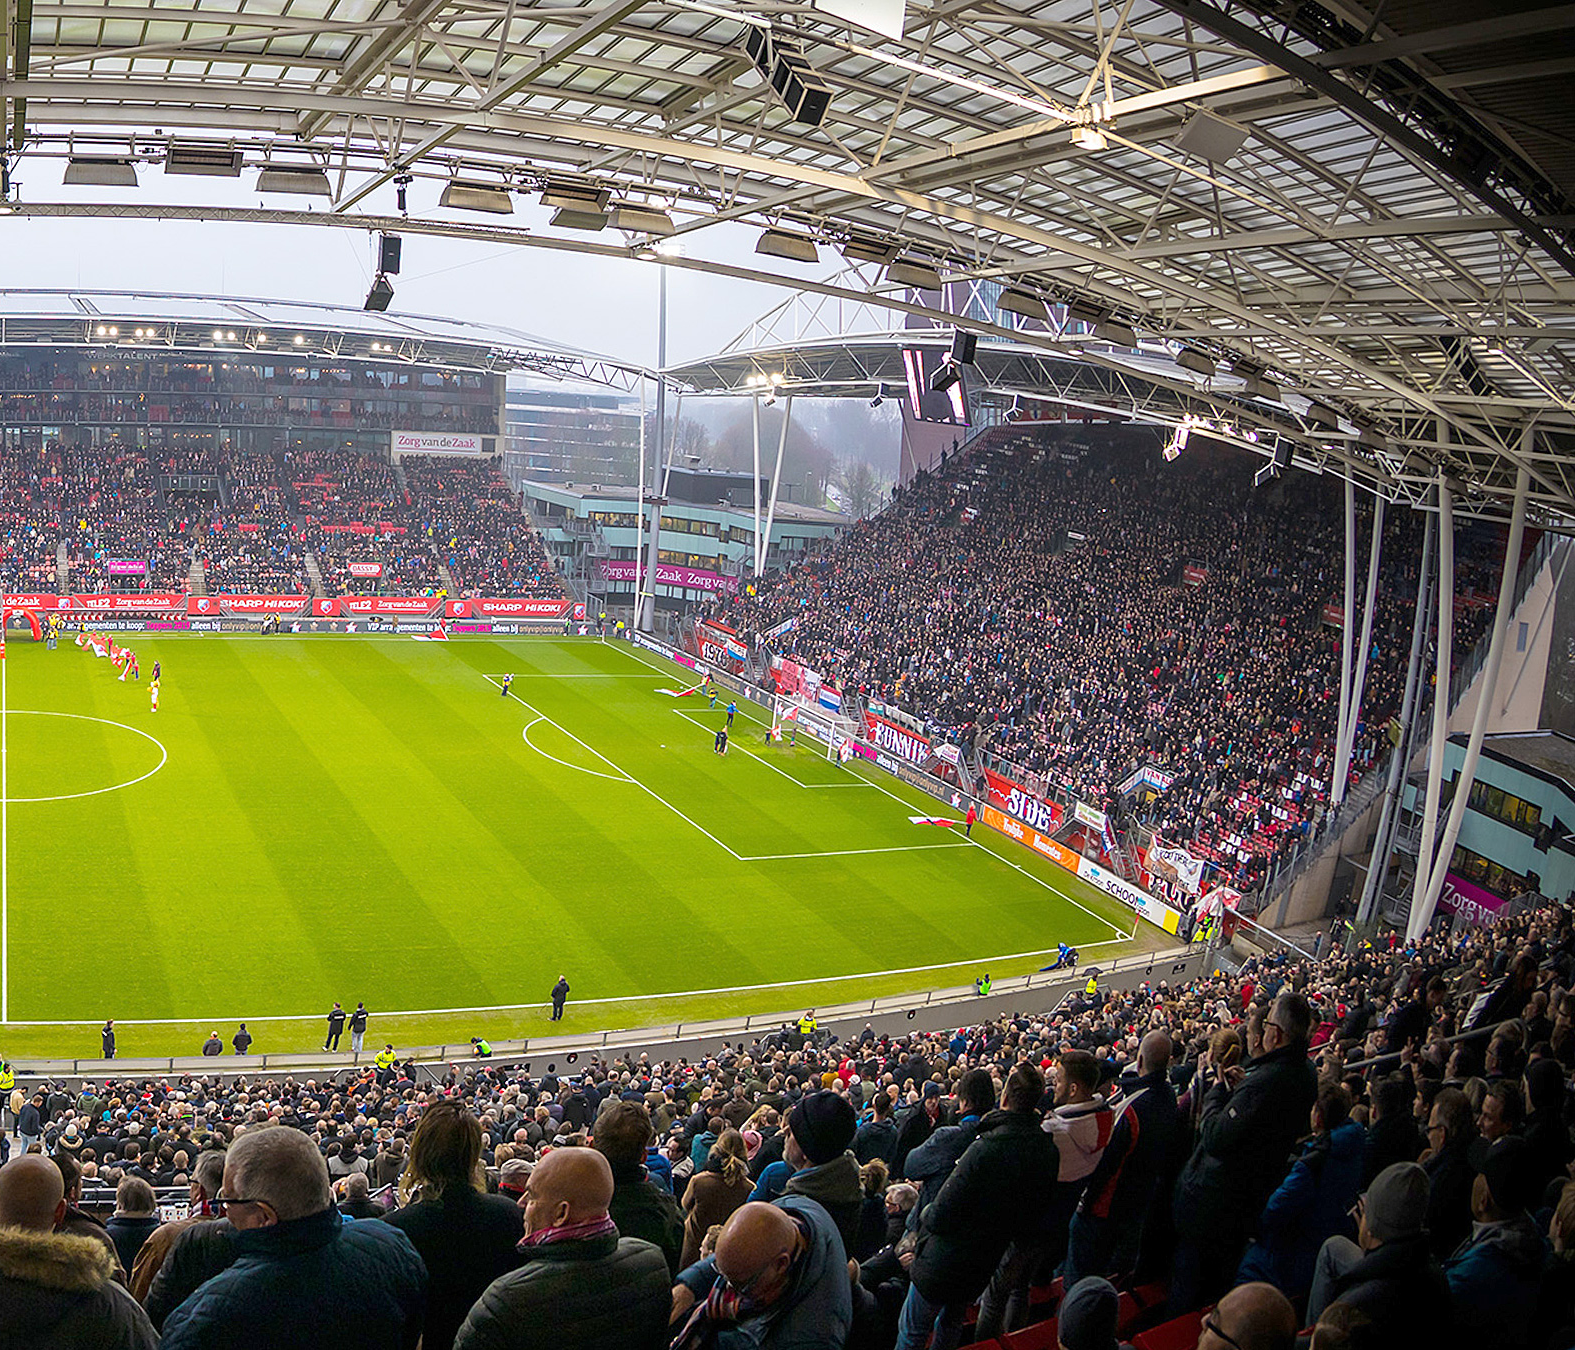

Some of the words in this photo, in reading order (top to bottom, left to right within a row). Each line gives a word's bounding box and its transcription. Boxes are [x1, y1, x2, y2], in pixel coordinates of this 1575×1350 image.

[398, 435, 421, 448] Zorg
[452, 438, 475, 448] Zaak
[656, 568, 682, 583] Zaak
[687, 573, 713, 588] Zorg
[17, 597, 40, 605] Zaak
[87, 598, 110, 607] TELE2
[349, 600, 371, 610] TELE2
[483, 603, 522, 611] SHARP
[118, 621, 126, 629] te
[191, 622, 211, 630] alleen
[212, 622, 221, 632] bij
[367, 622, 379, 630] VIP
[492, 624, 510, 632] alleen
[875, 722, 929, 764] BUNNIK
[1008, 788, 1051, 834] SIDE
[1442, 882, 1478, 920] Zorg
